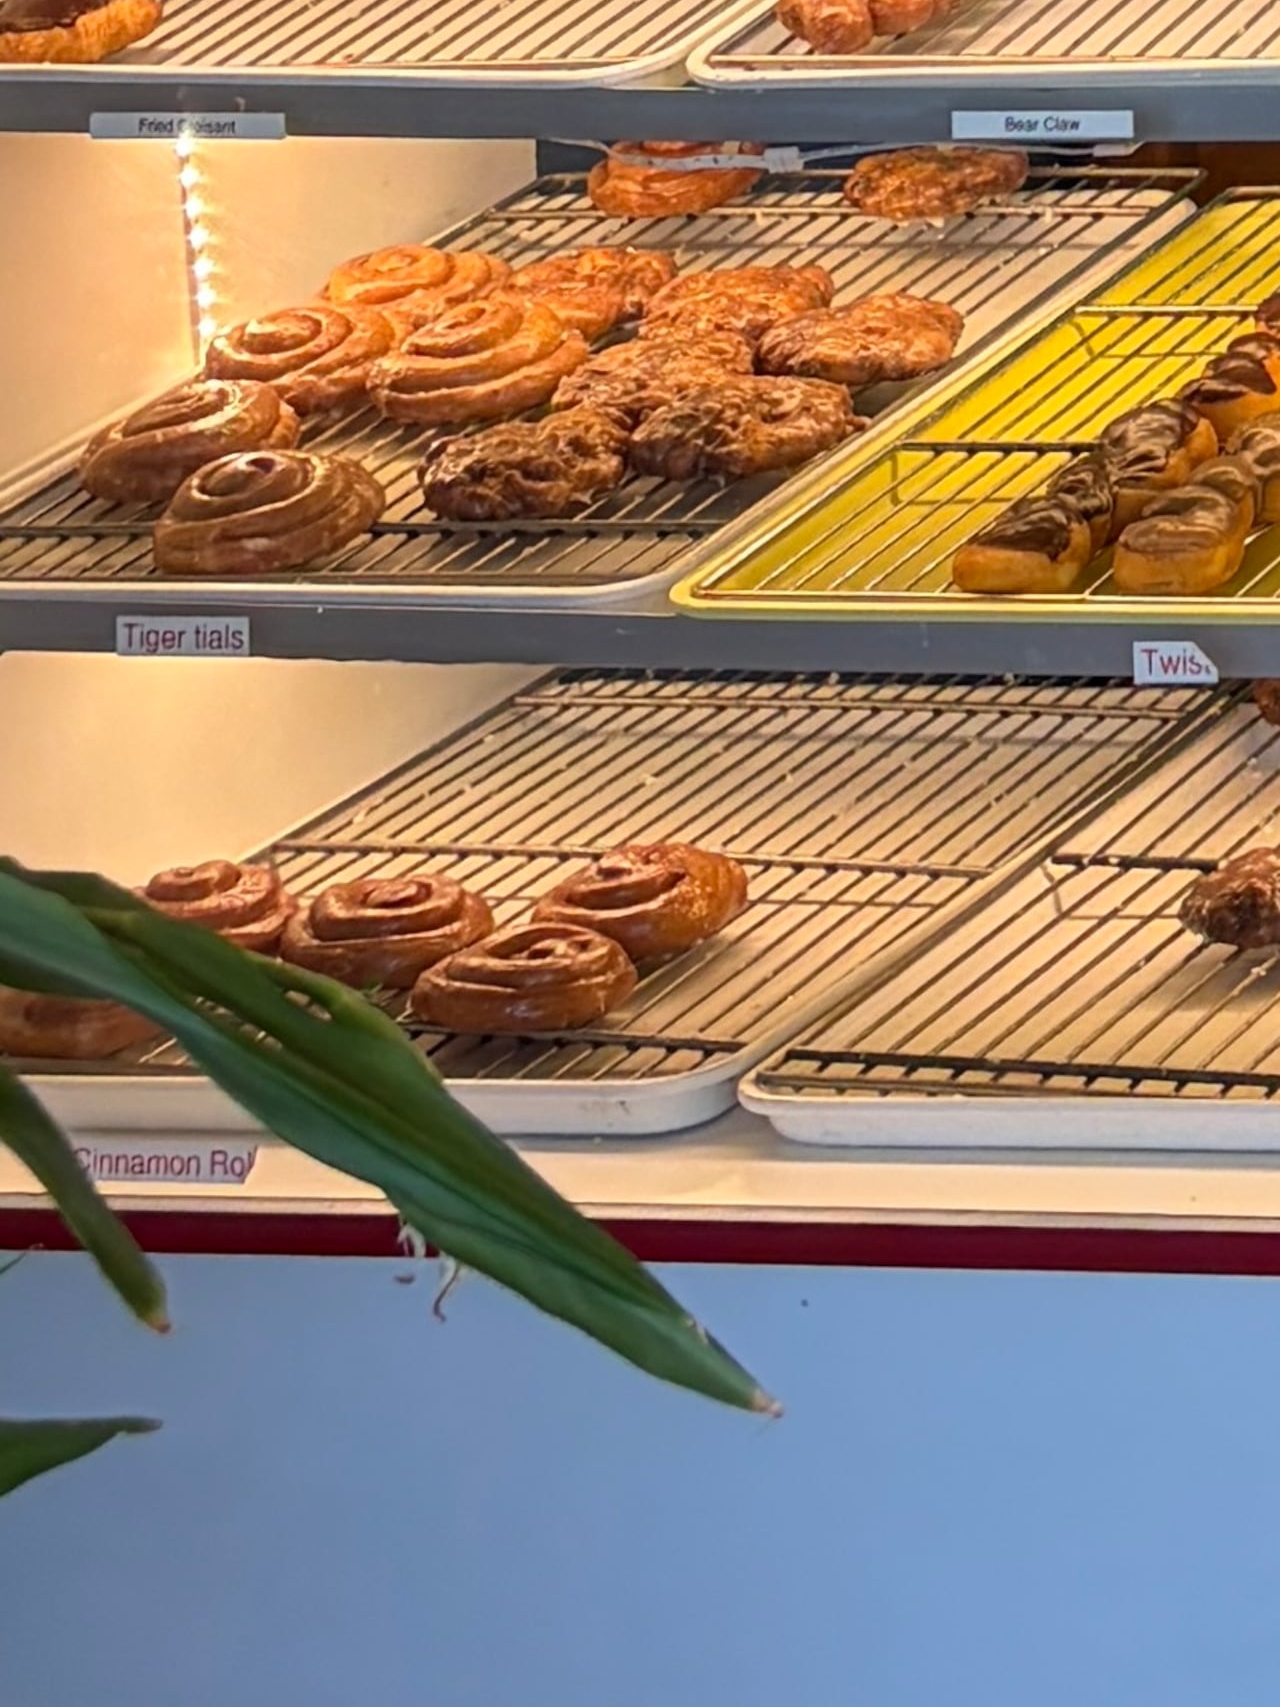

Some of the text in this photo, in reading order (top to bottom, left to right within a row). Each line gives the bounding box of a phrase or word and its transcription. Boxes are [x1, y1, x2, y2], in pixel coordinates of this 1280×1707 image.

[1005, 116, 1080, 132] Bear Claw
[123, 623, 244, 653] Tiger tials
[74, 1148, 200, 1176] Cinnamon
